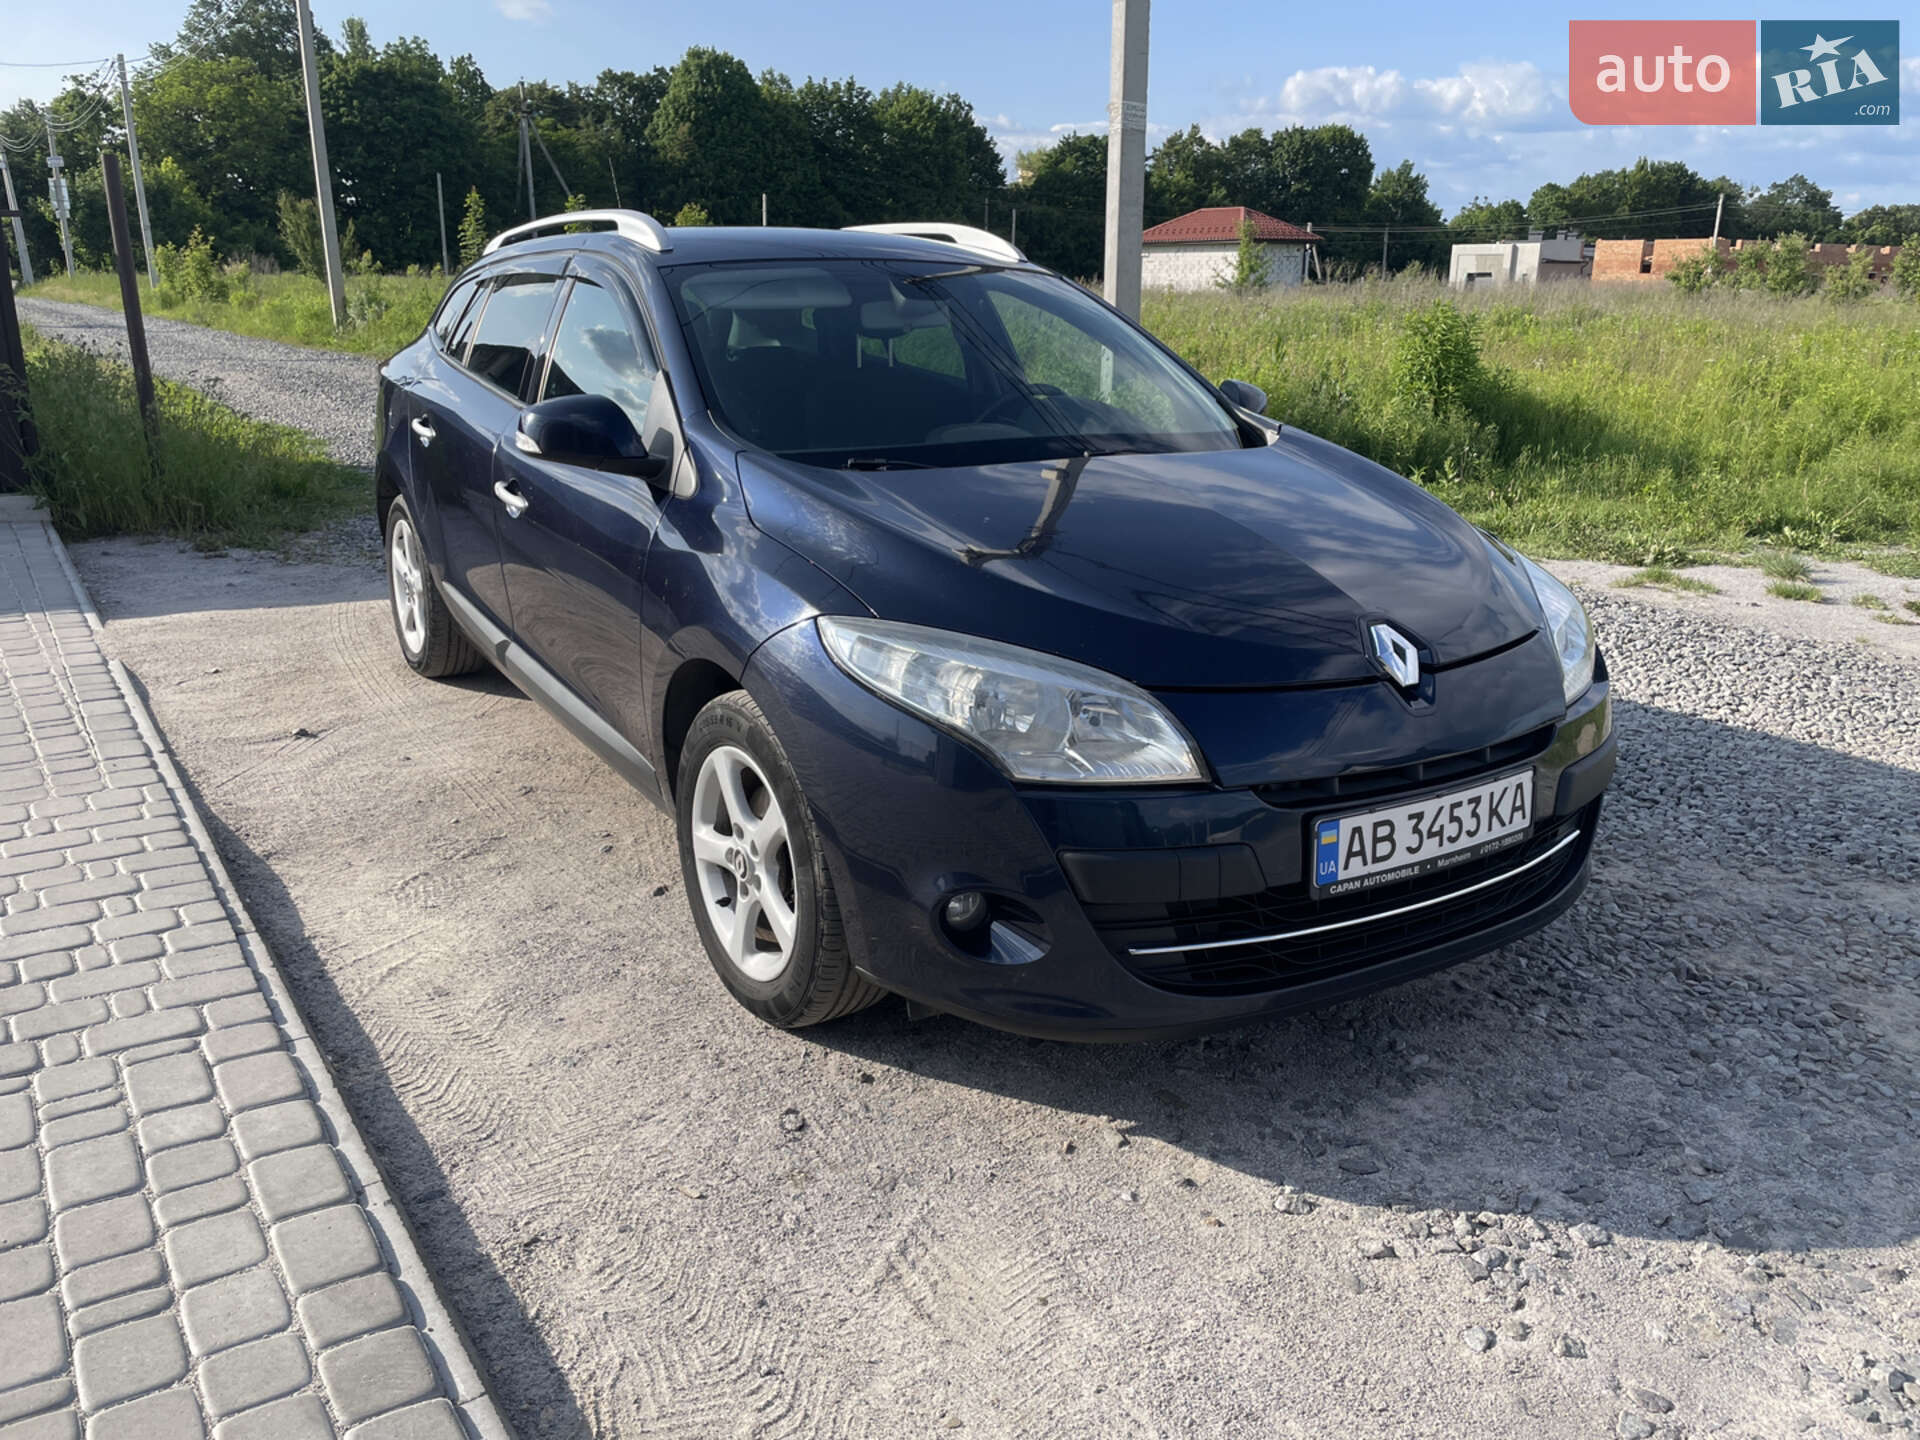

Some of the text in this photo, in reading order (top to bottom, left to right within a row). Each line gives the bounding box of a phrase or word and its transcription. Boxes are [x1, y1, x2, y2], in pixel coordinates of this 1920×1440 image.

[1343, 782, 1526, 871] AB 3453 KA
[1319, 860, 1337, 876] UA
[1329, 880, 1361, 894] CAPAN
[1363, 865, 1420, 887] AUTOMOBILE
